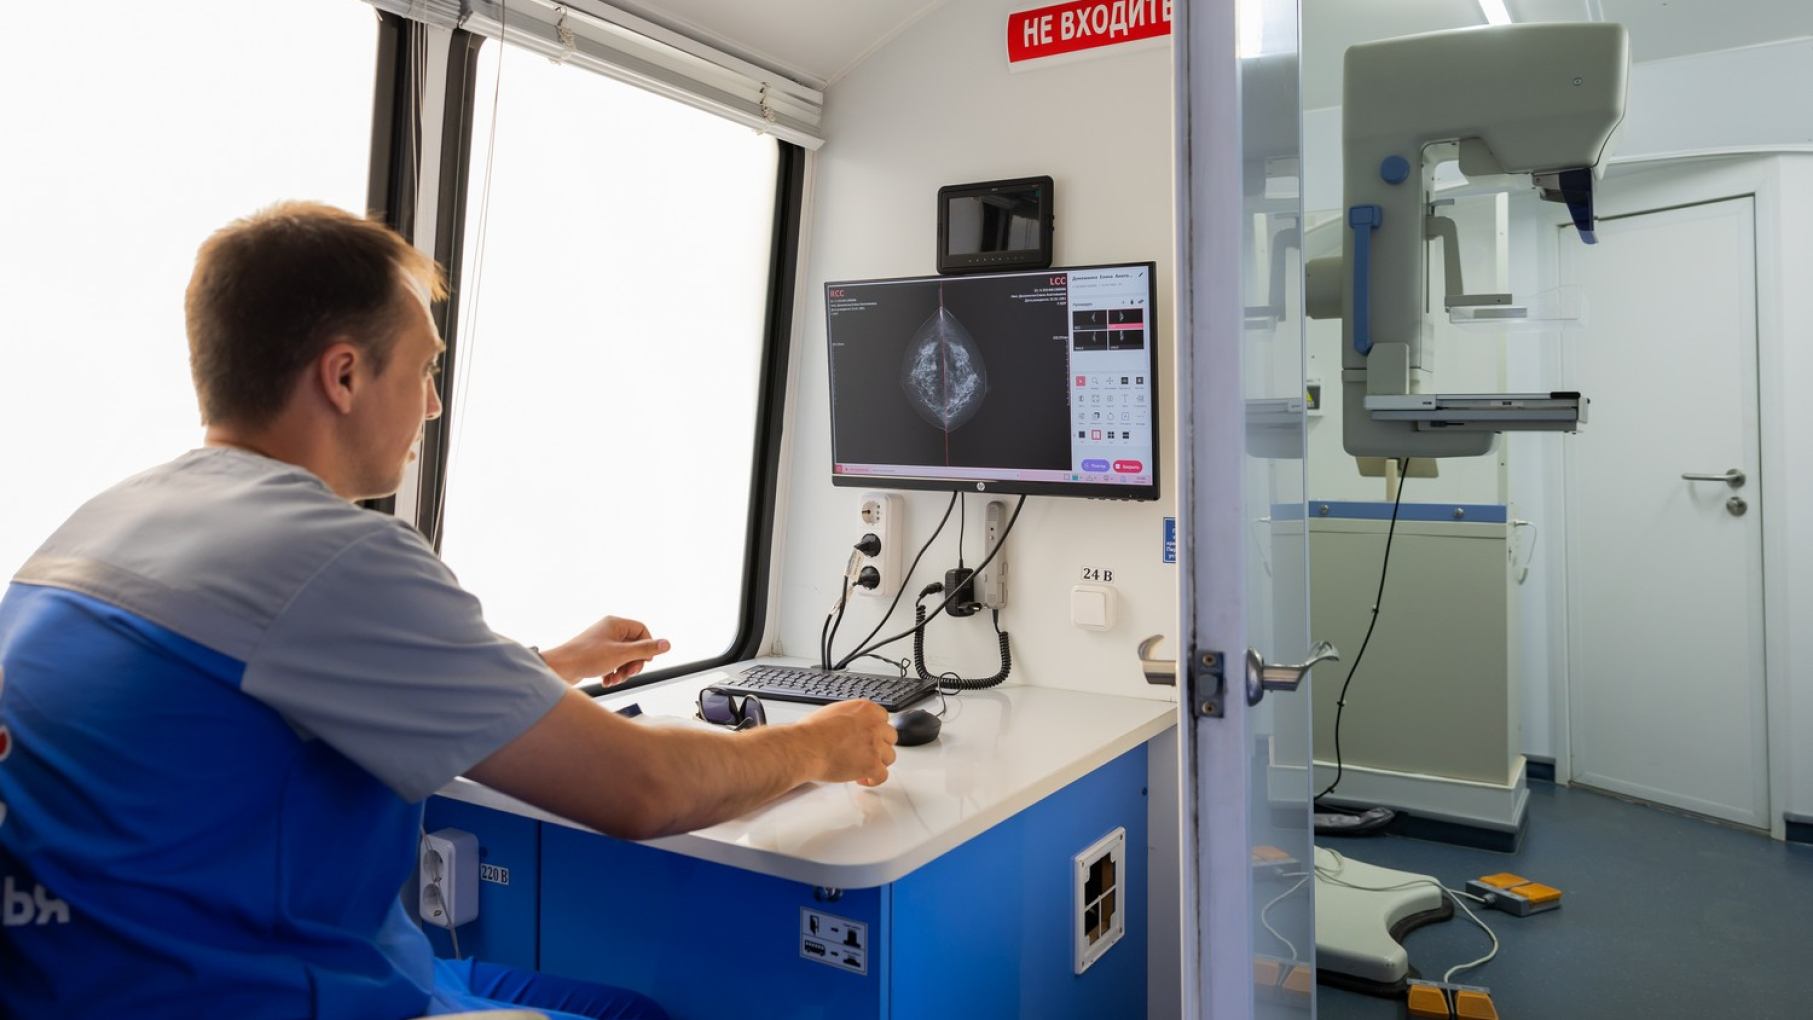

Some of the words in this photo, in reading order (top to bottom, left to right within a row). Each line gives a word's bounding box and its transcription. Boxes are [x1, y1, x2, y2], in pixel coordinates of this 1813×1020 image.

[1024, 14, 1053, 47] НЕ
[1049, 277, 1066, 285] LCC
[1083, 567, 1100, 580] 24
[1103, 570, 1113, 582] В
[482, 866, 498, 880] 220
[501, 870, 508, 882] В
